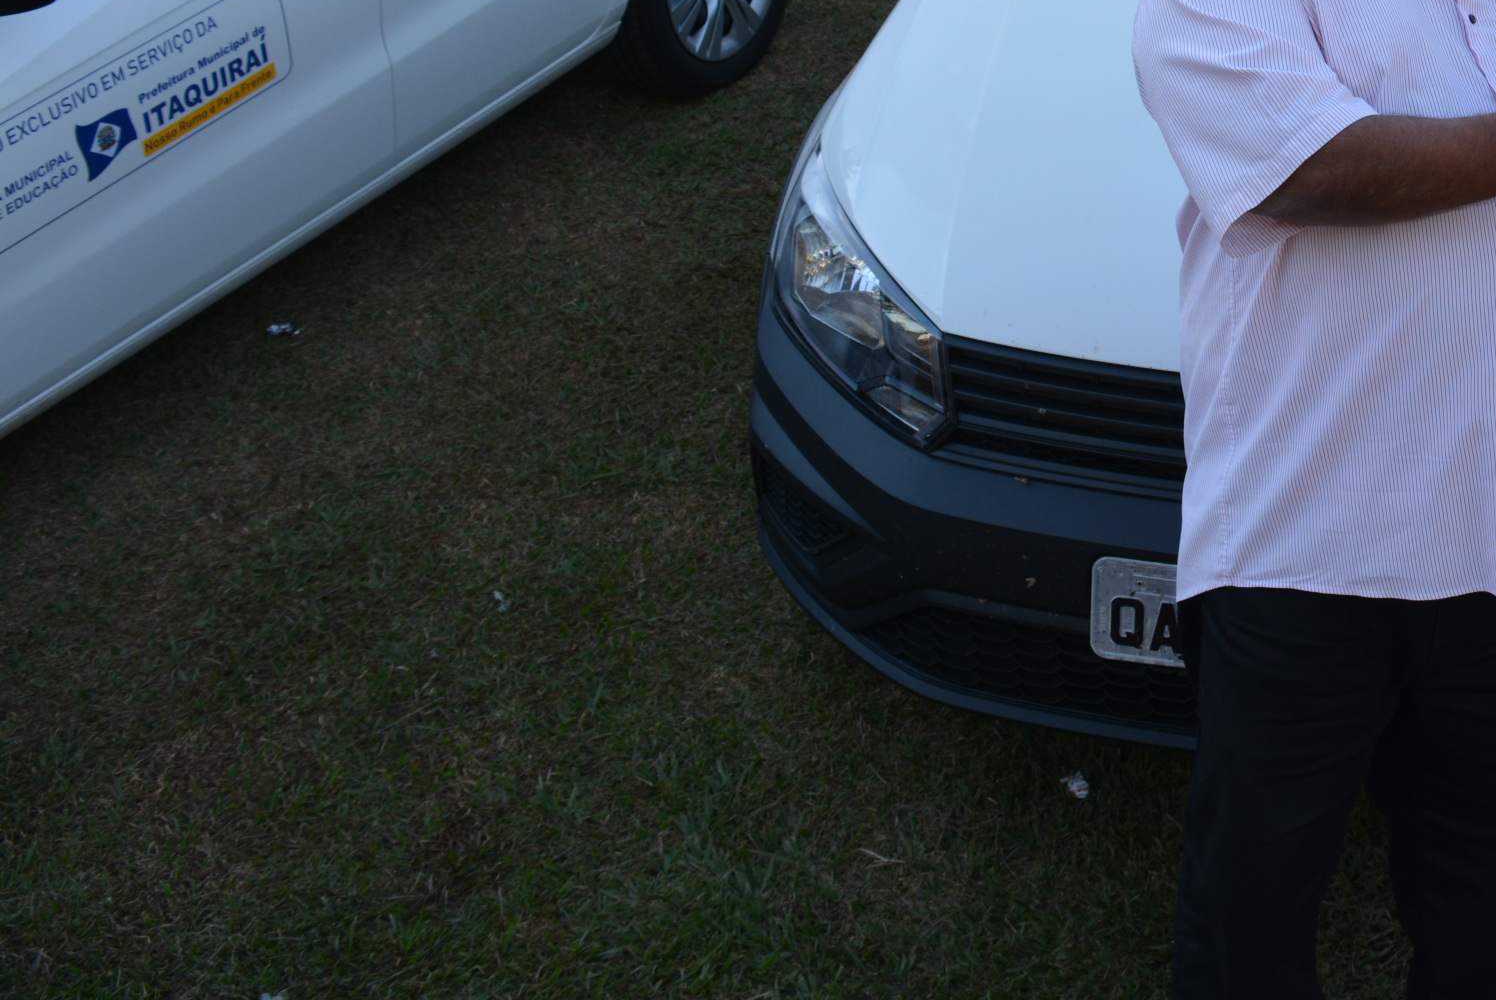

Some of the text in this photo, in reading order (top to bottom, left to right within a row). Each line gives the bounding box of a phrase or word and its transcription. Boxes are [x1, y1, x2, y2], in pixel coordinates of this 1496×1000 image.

[5, 82, 99, 146] EXCLUSIVO
[100, 66, 125, 92] EM
[127, 28, 194, 76] SERVIÇO
[194, 16, 218, 38] DA
[138, 25, 265, 104] Prefeitura Municipal de
[142, 33, 269, 134] ITAQUIRAÍ
[144, 128, 178, 153] Nosso
[178, 109, 208, 132] Rumo
[217, 89, 240, 109] Para
[240, 69, 272, 96] Frente
[4, 151, 74, 197] MUNICIPAL
[6, 164, 78, 215] EDUCAÇÃO
